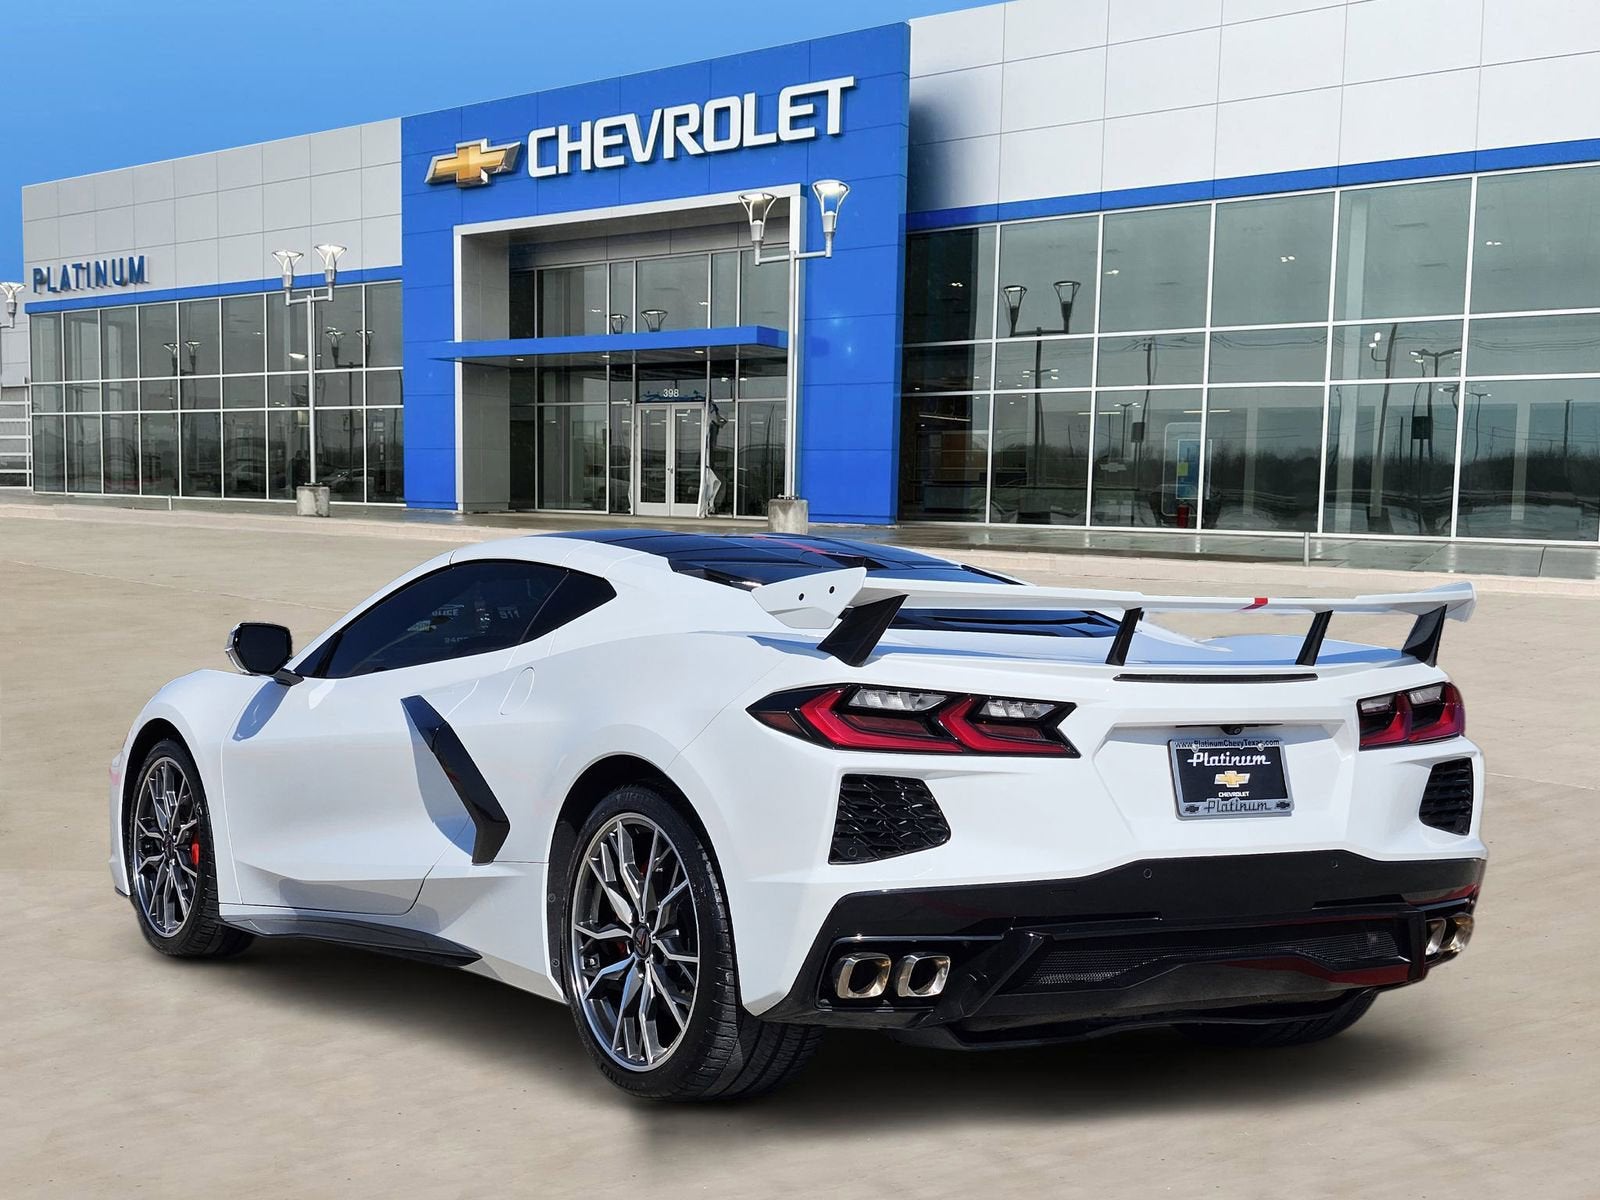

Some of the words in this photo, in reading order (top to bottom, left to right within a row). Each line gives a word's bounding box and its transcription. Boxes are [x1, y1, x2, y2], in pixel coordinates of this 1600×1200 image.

[528, 76, 855, 178] CHEVROLET
[33, 255, 147, 294] PLATINUM
[663, 388, 679, 398] 398
[1187, 752, 1271, 767] Platinum
[1204, 799, 1271, 813] Platinum
